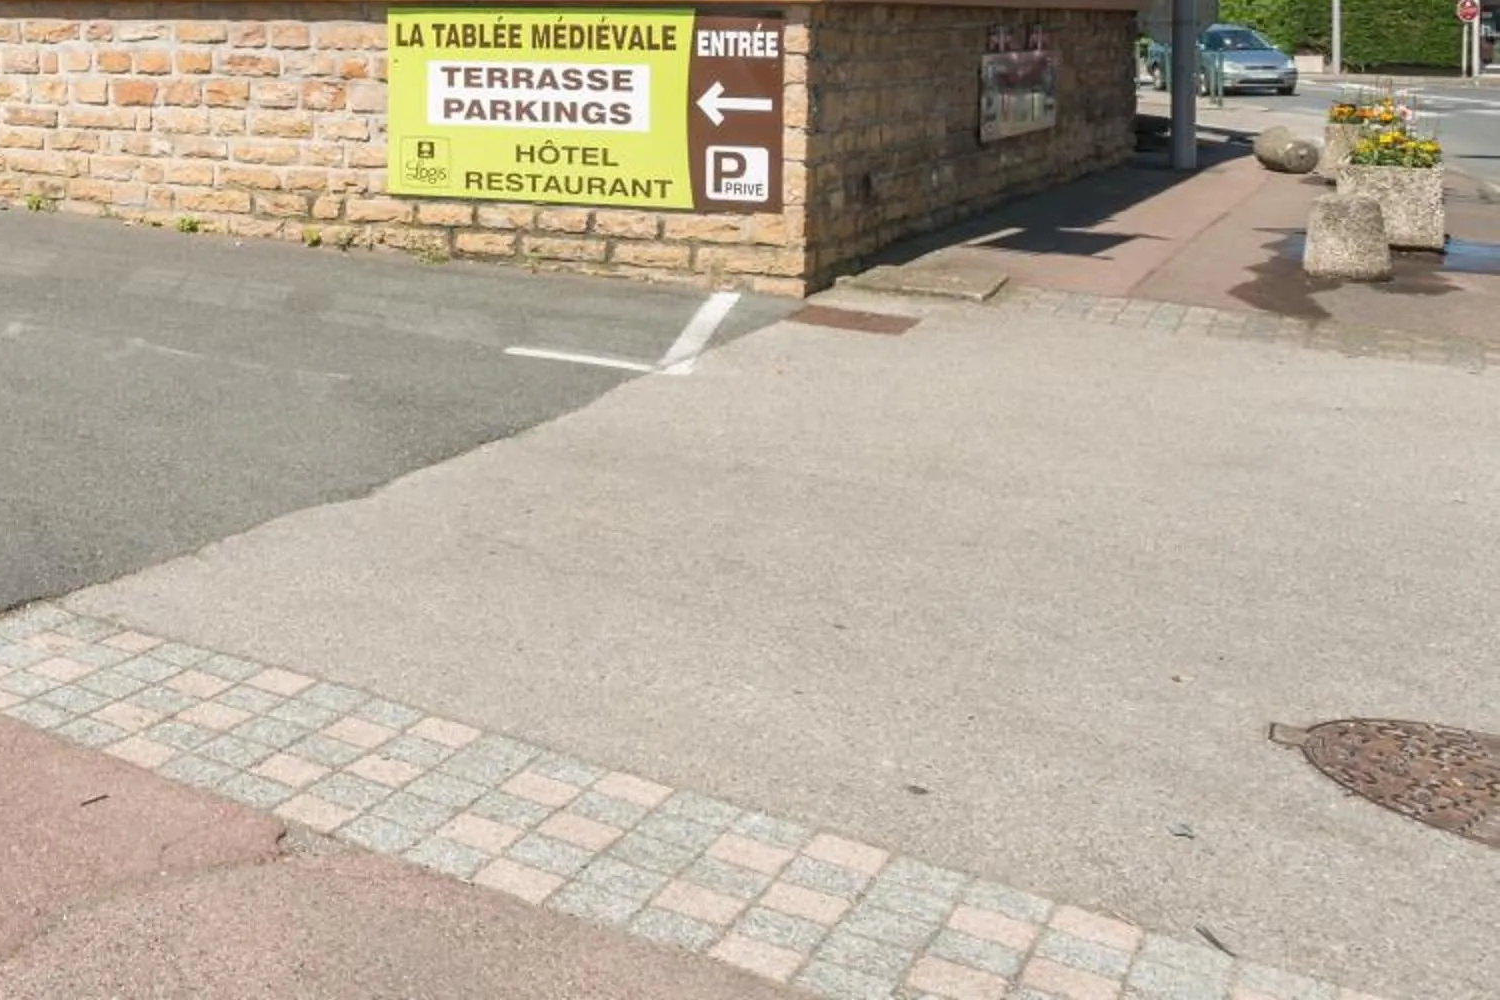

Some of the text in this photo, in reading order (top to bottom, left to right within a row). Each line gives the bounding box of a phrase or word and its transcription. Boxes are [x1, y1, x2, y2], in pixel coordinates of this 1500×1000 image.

[395, 15, 677, 51] LA TABLÉE MÉDIÉVALE
[697, 23, 779, 58] ENTRÉE
[441, 66, 634, 91] TERRASSE
[443, 99, 632, 125] PARKINGS
[515, 139, 620, 167] HÔTEL
[464, 170, 673, 199] RESTAURANT
[713, 151, 747, 193] P
